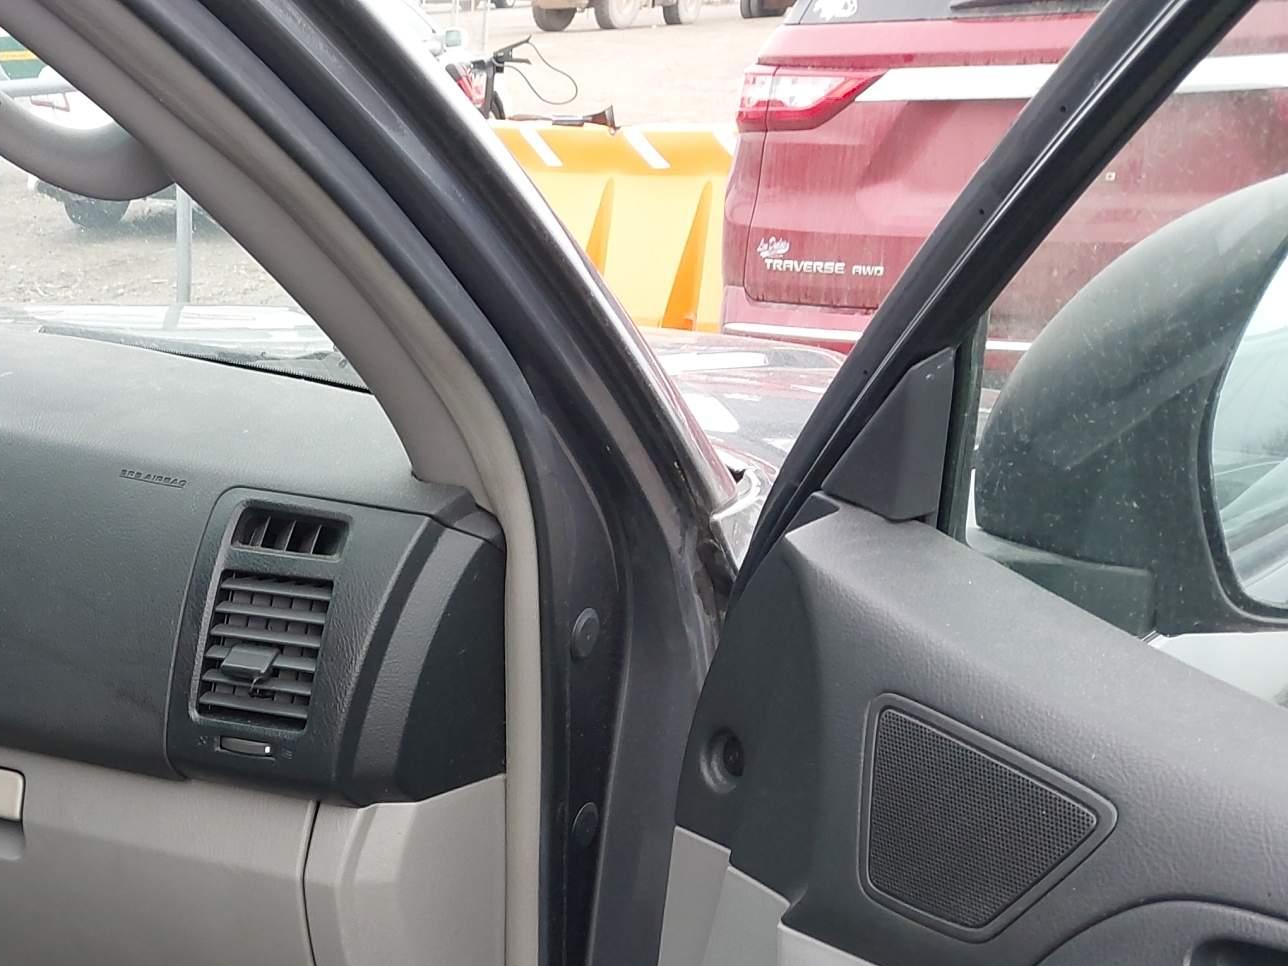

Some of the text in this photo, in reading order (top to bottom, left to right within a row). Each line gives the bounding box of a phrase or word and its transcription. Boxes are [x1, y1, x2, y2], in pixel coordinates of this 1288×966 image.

[764, 258, 884, 277] TRAVERSE AWD
[143, 473, 187, 487] AIRBAG
